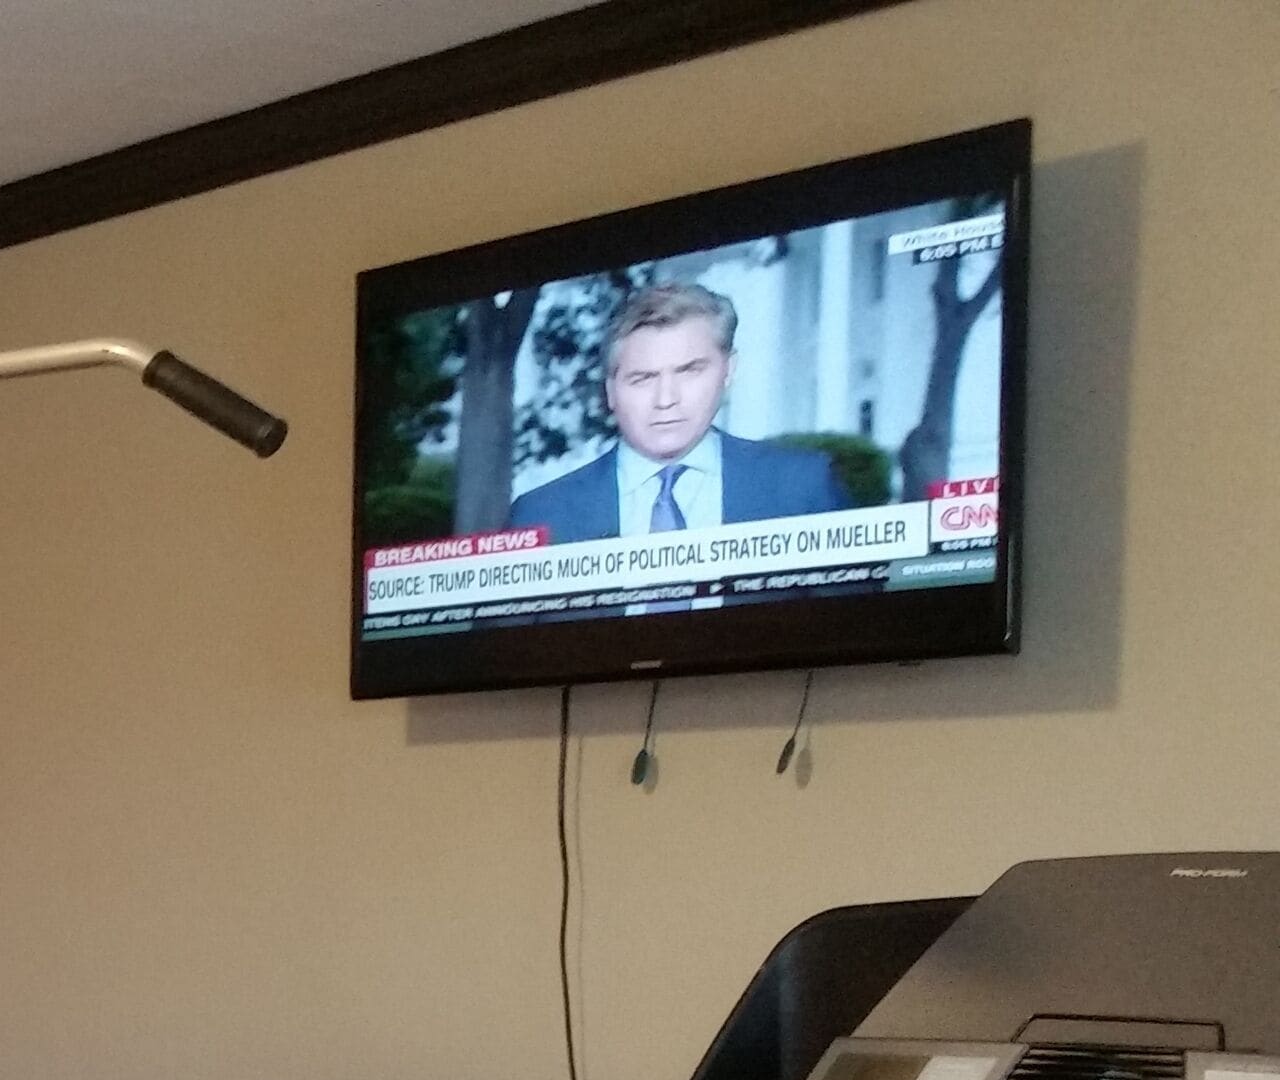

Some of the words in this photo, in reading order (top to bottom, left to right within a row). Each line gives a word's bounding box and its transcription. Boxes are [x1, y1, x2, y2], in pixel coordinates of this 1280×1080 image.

[943, 479, 999, 498] LIV
[369, 575, 424, 600] SOURCE:
[430, 570, 475, 594] TRUMP
[479, 561, 552, 588] DIRECTING
[557, 555, 600, 579] MUCH
[605, 552, 625, 574] OF
[629, 543, 705, 571] POLITICAL
[710, 533, 791, 562] STRATEGY
[797, 530, 820, 553] ON
[826, 520, 906, 550] MUELLER
[374, 538, 473, 567] BREAKING
[478, 530, 538, 554] NEWS
